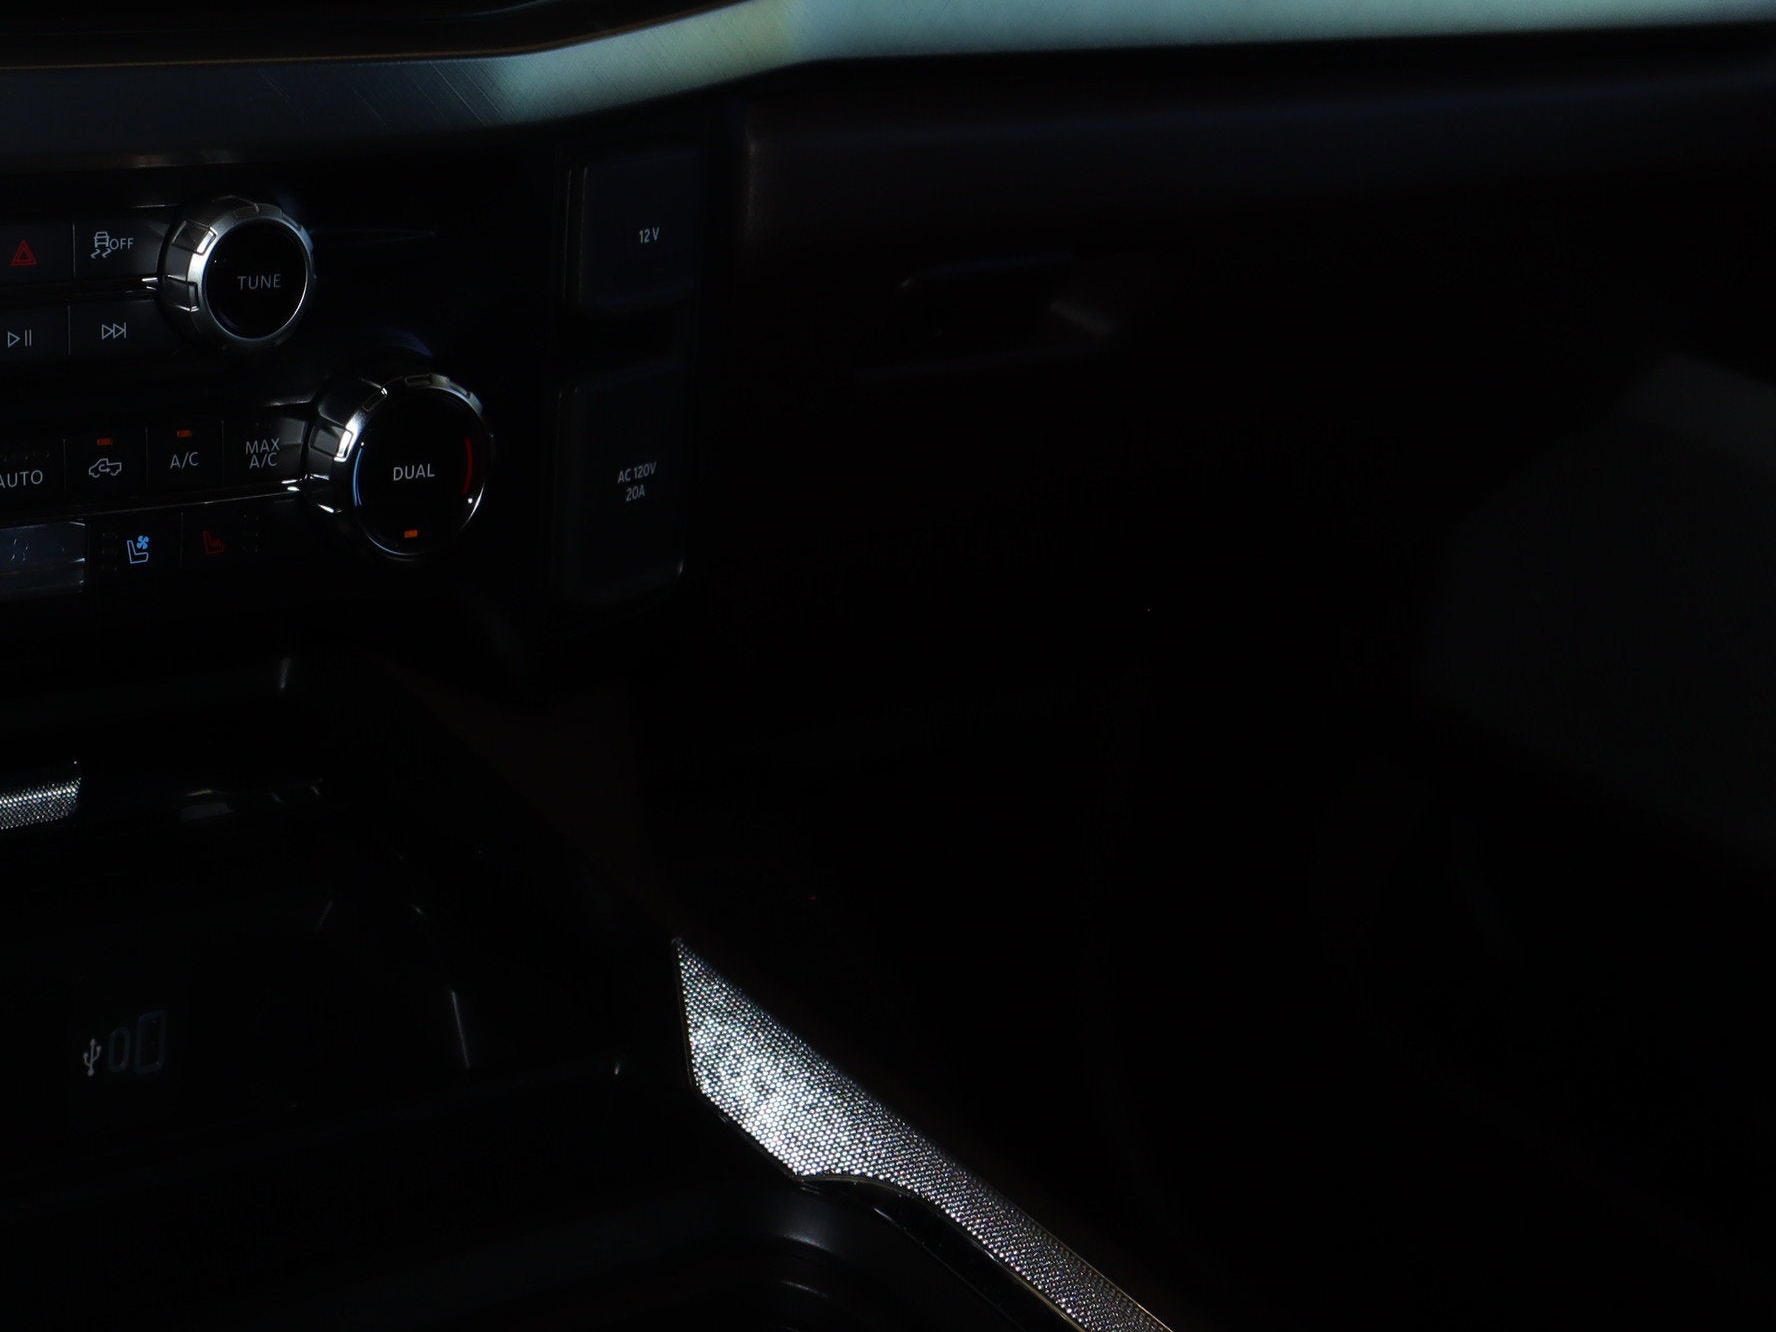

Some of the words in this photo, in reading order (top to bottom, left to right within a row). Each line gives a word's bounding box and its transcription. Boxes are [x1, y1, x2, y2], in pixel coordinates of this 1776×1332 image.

[110, 237, 135, 250] OFF
[236, 273, 282, 291] TUNE
[245, 438, 280, 454] MAX
[169, 451, 199, 470] A/C
[249, 453, 278, 469] A/C
[393, 464, 435, 481] DUAL
[617, 468, 632, 484] AC
